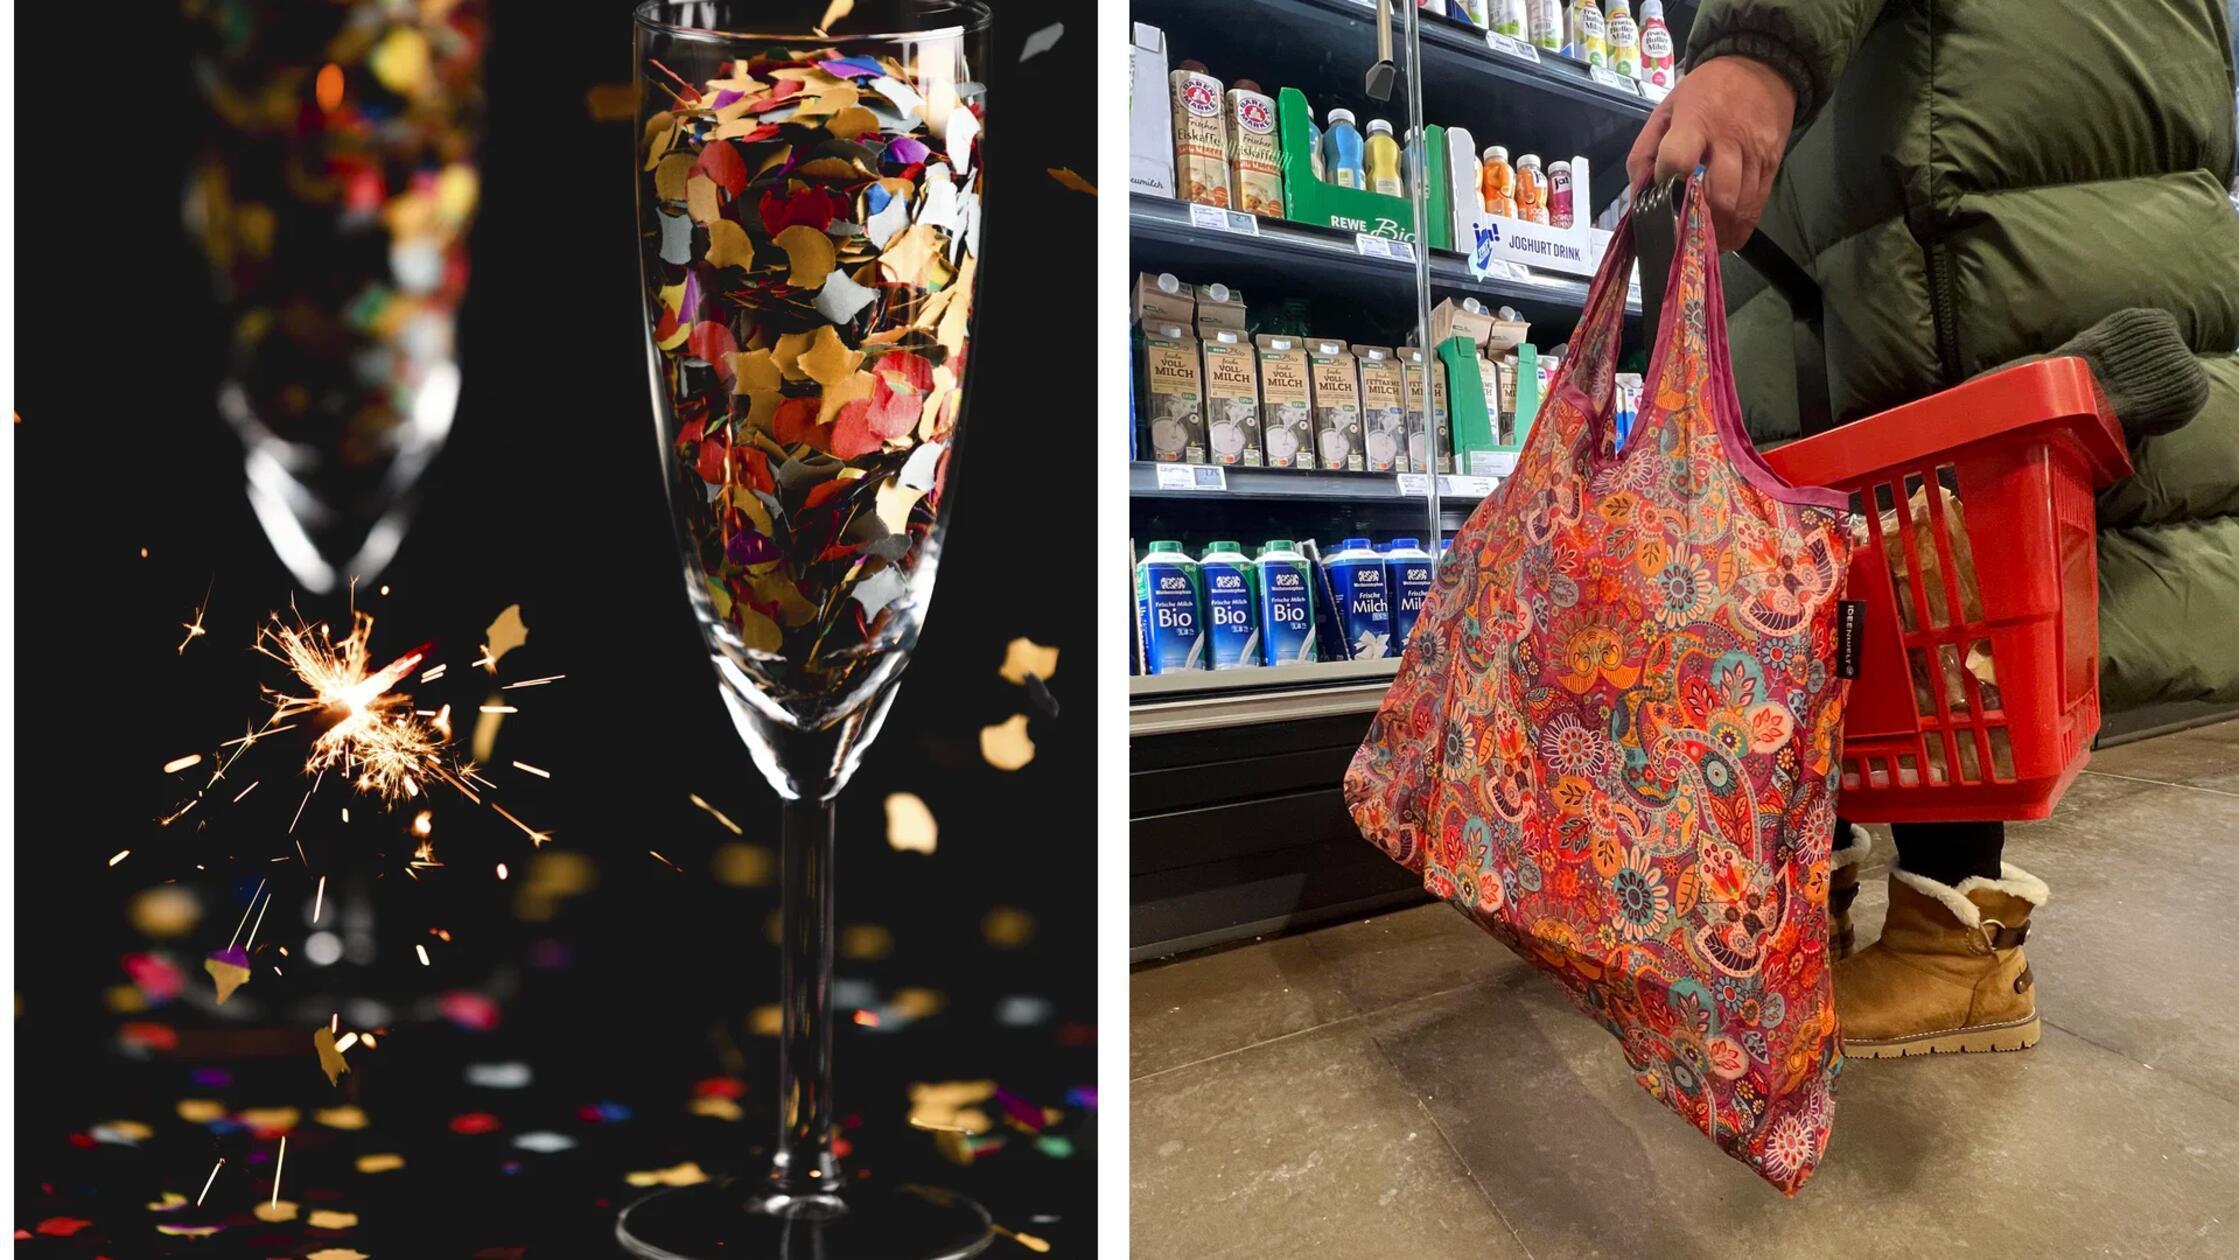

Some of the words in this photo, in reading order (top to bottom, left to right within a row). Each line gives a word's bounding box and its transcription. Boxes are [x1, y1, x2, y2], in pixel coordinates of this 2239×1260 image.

[1178, 128, 1223, 146] Eiskaffe
[1331, 215, 1367, 232] REWE
[1370, 218, 1416, 243] Bio
[1508, 234, 1552, 256] JOGHURT
[1553, 243, 1581, 261] DRINK
[1160, 359, 1187, 368] VOLL-
[1219, 365, 1243, 373] VOLL-
[1155, 366, 1194, 379] MILCH
[1213, 372, 1250, 383] MILCH
[1273, 371, 1296, 379] VOLL-
[1267, 378, 1303, 388] MILCH
[1319, 382, 1352, 392] MILCH
[1366, 378, 1401, 387] FETTARME
[1368, 386, 1400, 396] MILCH
[1352, 599, 1388, 614] Milch
[1401, 597, 1422, 611] Mil
[1158, 607, 1193, 628] Bio
[1214, 605, 1247, 625] Bio
[1273, 603, 1305, 622] Bio
